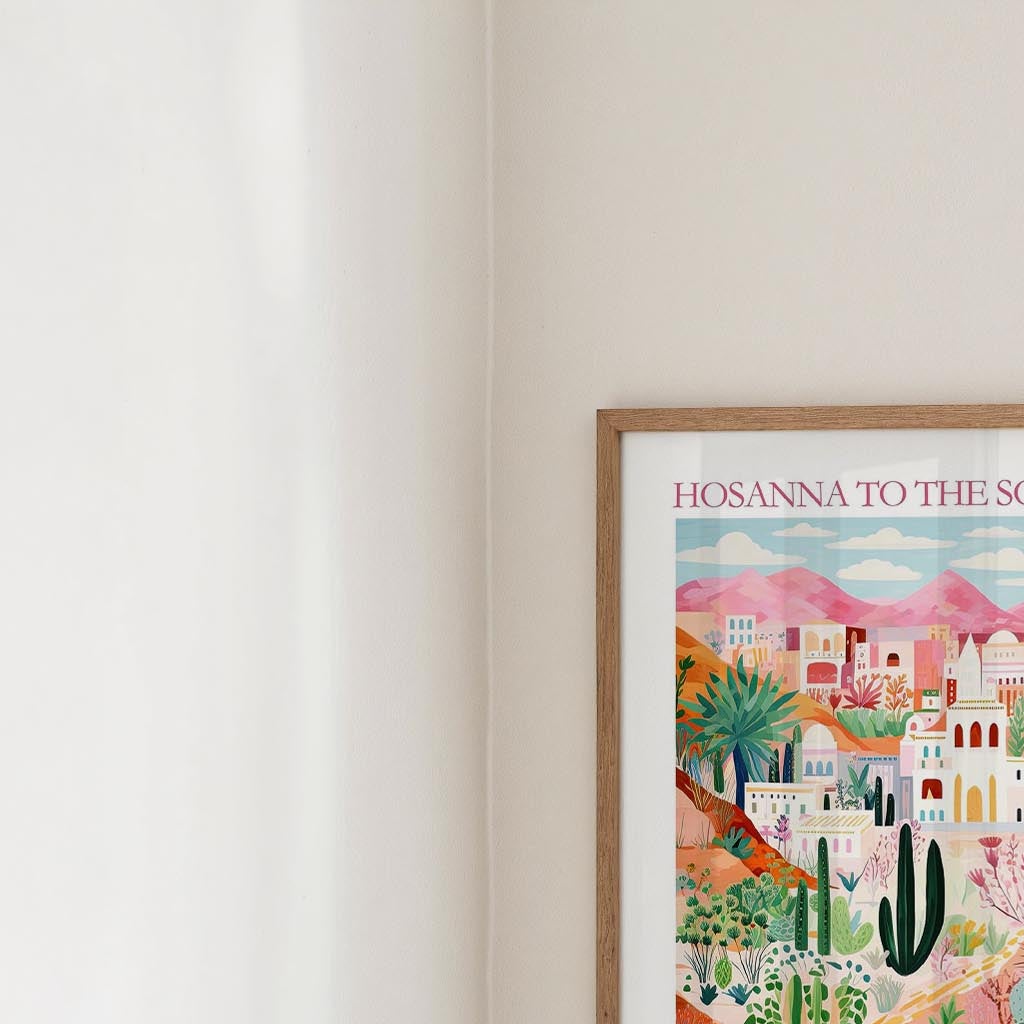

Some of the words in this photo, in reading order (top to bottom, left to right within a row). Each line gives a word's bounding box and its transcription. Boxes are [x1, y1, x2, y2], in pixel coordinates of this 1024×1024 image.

[673, 480, 849, 508] HOSANNA
[856, 480, 907, 507] TO
[914, 480, 988, 506] THE
